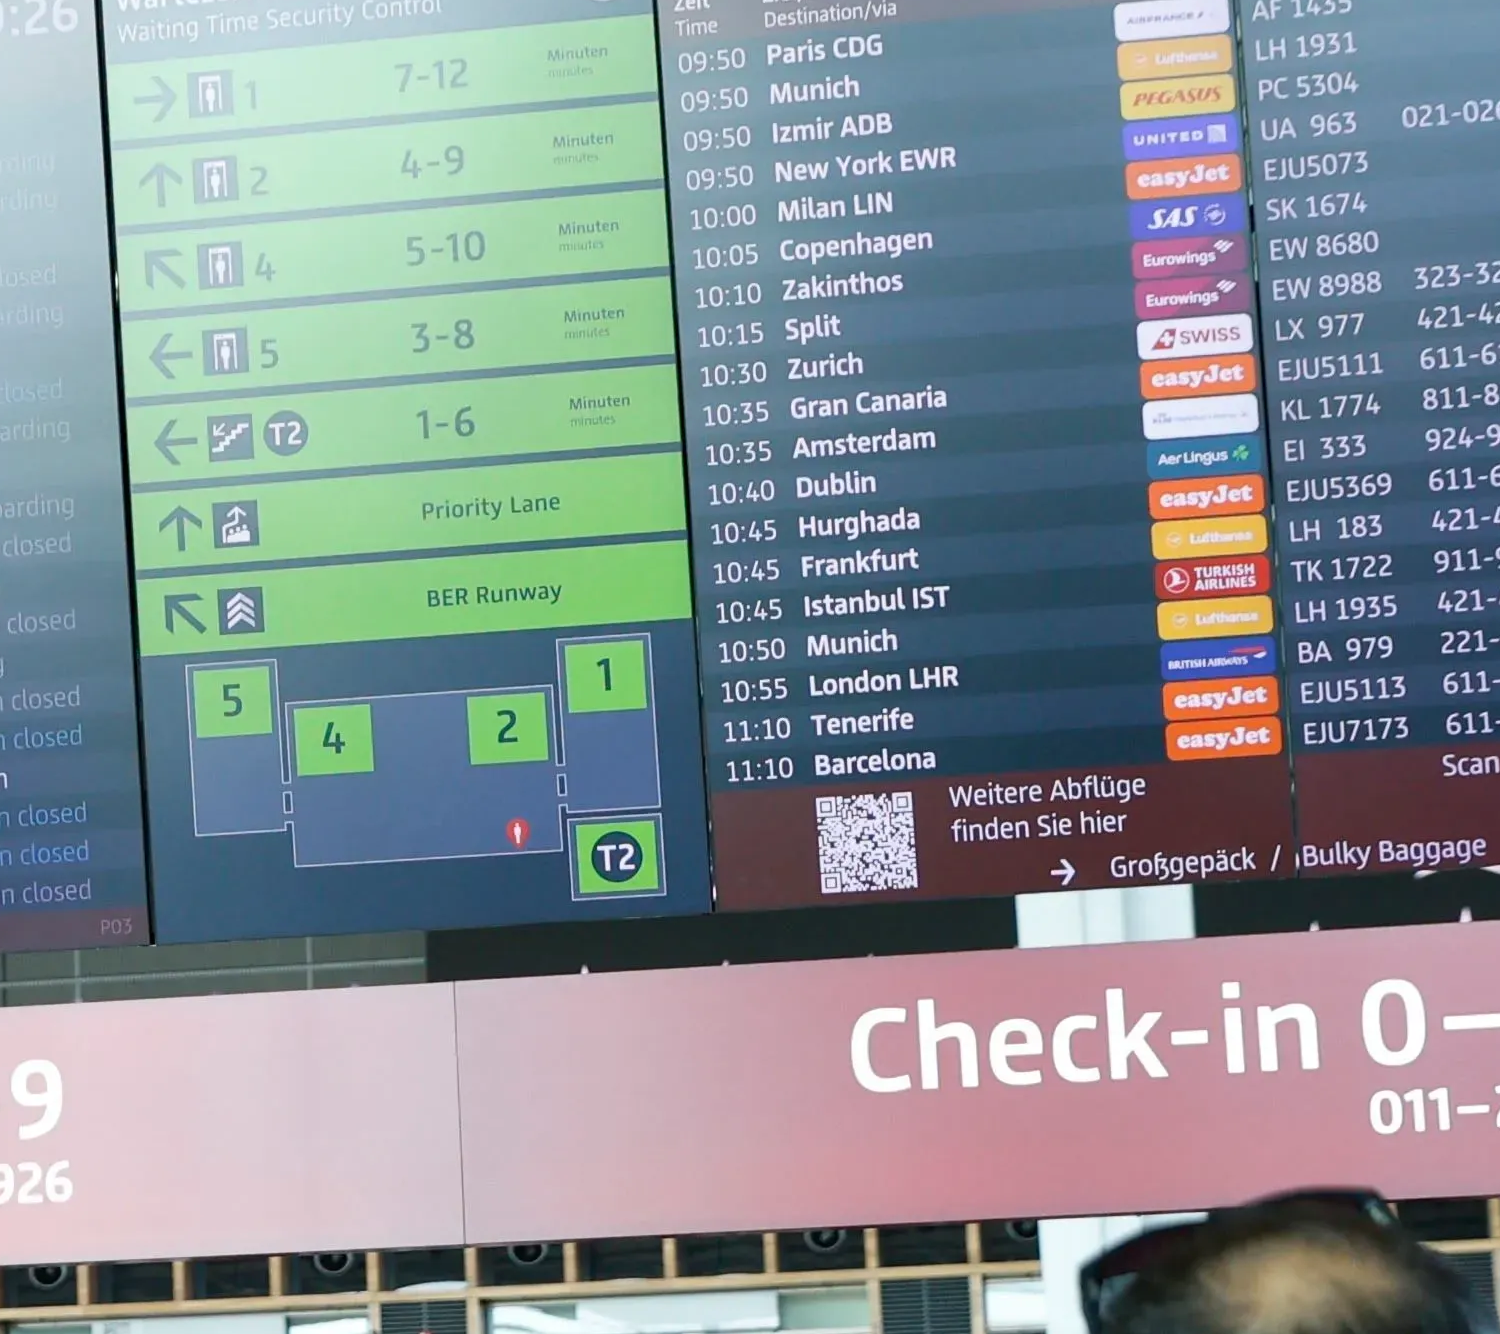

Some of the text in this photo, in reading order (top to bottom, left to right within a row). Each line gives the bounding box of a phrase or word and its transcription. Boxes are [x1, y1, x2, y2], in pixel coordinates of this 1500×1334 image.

[116, 20, 199, 44] Waiting
[205, 12, 259, 36] Time
[265, 2, 355, 30] Security
[674, 18, 719, 37] Time
[244, 45, 609, 111] 1 7-12 Minuten
[1260, 117, 1297, 142] UA
[1309, 111, 1357, 138] 963
[686, 146, 957, 191] 09:50 New York EWR
[1136, 163, 1231, 189] easyJet
[1142, 250, 1217, 268] Eurowings
[268, 405, 476, 446] T2 1-6
[421, 496, 561, 521] Priority Lane
[1193, 562, 1255, 579] TURKISH
[1193, 575, 1257, 592] AIRLINES
[1289, 559, 1324, 583] TK
[1330, 554, 1393, 580] 1722
[426, 584, 563, 608] BER Runway
[598, 659, 611, 690] 1
[222, 683, 243, 718] 5
[322, 721, 346, 755] 4
[496, 709, 519, 744] 2
[1303, 716, 1409, 745] EJU7173
[1442, 753, 1500, 777] Scan
[948, 774, 1146, 808] Weitere Abflüge
[950, 809, 1128, 843] finden Sie hier
[596, 843, 636, 872] T2
[1110, 838, 1487, 882] Großgepäck / Bulky Baggage
[850, 981, 1320, 1093] Check-in
